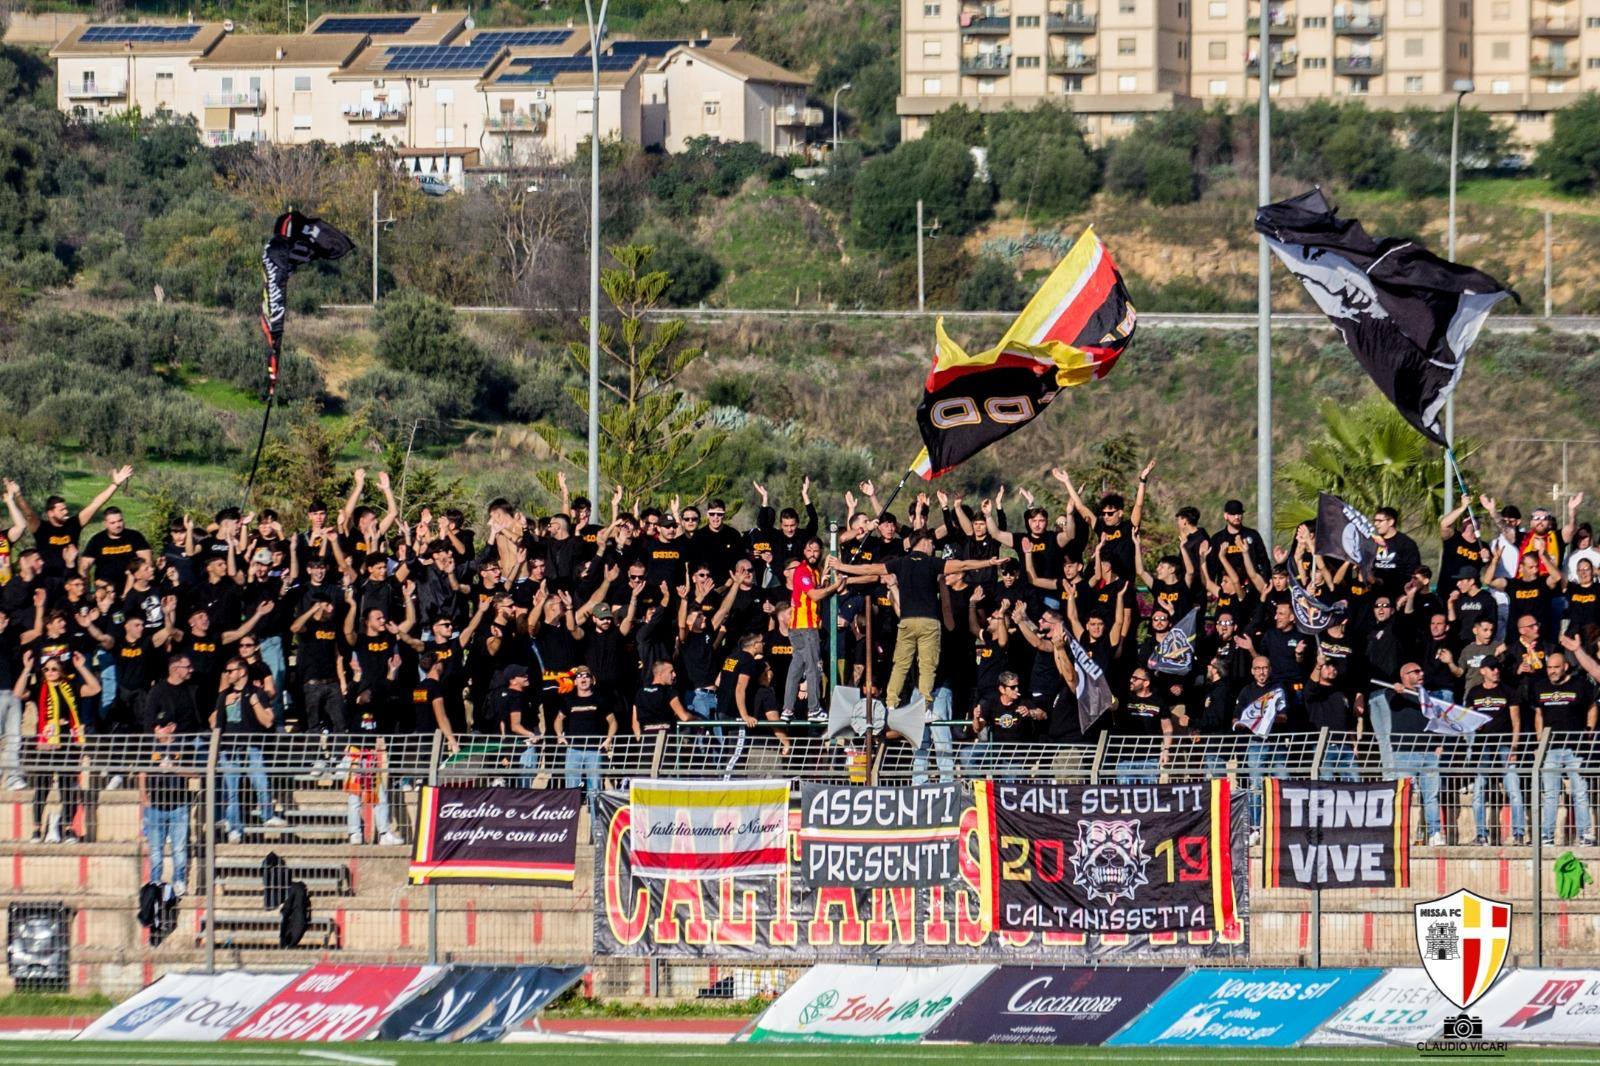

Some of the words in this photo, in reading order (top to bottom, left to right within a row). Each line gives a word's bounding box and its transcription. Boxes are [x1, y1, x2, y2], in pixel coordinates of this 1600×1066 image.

[439, 802, 503, 819] Teschio
[505, 809, 517, 819] e
[808, 787, 955, 826] ASSENTI
[1000, 786, 1070, 814] CANI
[1081, 785, 1203, 814] SCIOLTI
[1282, 788, 1395, 828] TANO
[444, 827, 503, 846] sempre
[505, 831, 536, 842] con
[537, 829, 568, 843] noi
[809, 842, 951, 882] PRESENTI
[1288, 843, 1386, 883] VIVE
[1006, 903, 1206, 930] CALTANISSETTA
[1007, 976, 1122, 1013] CACCIATORE
